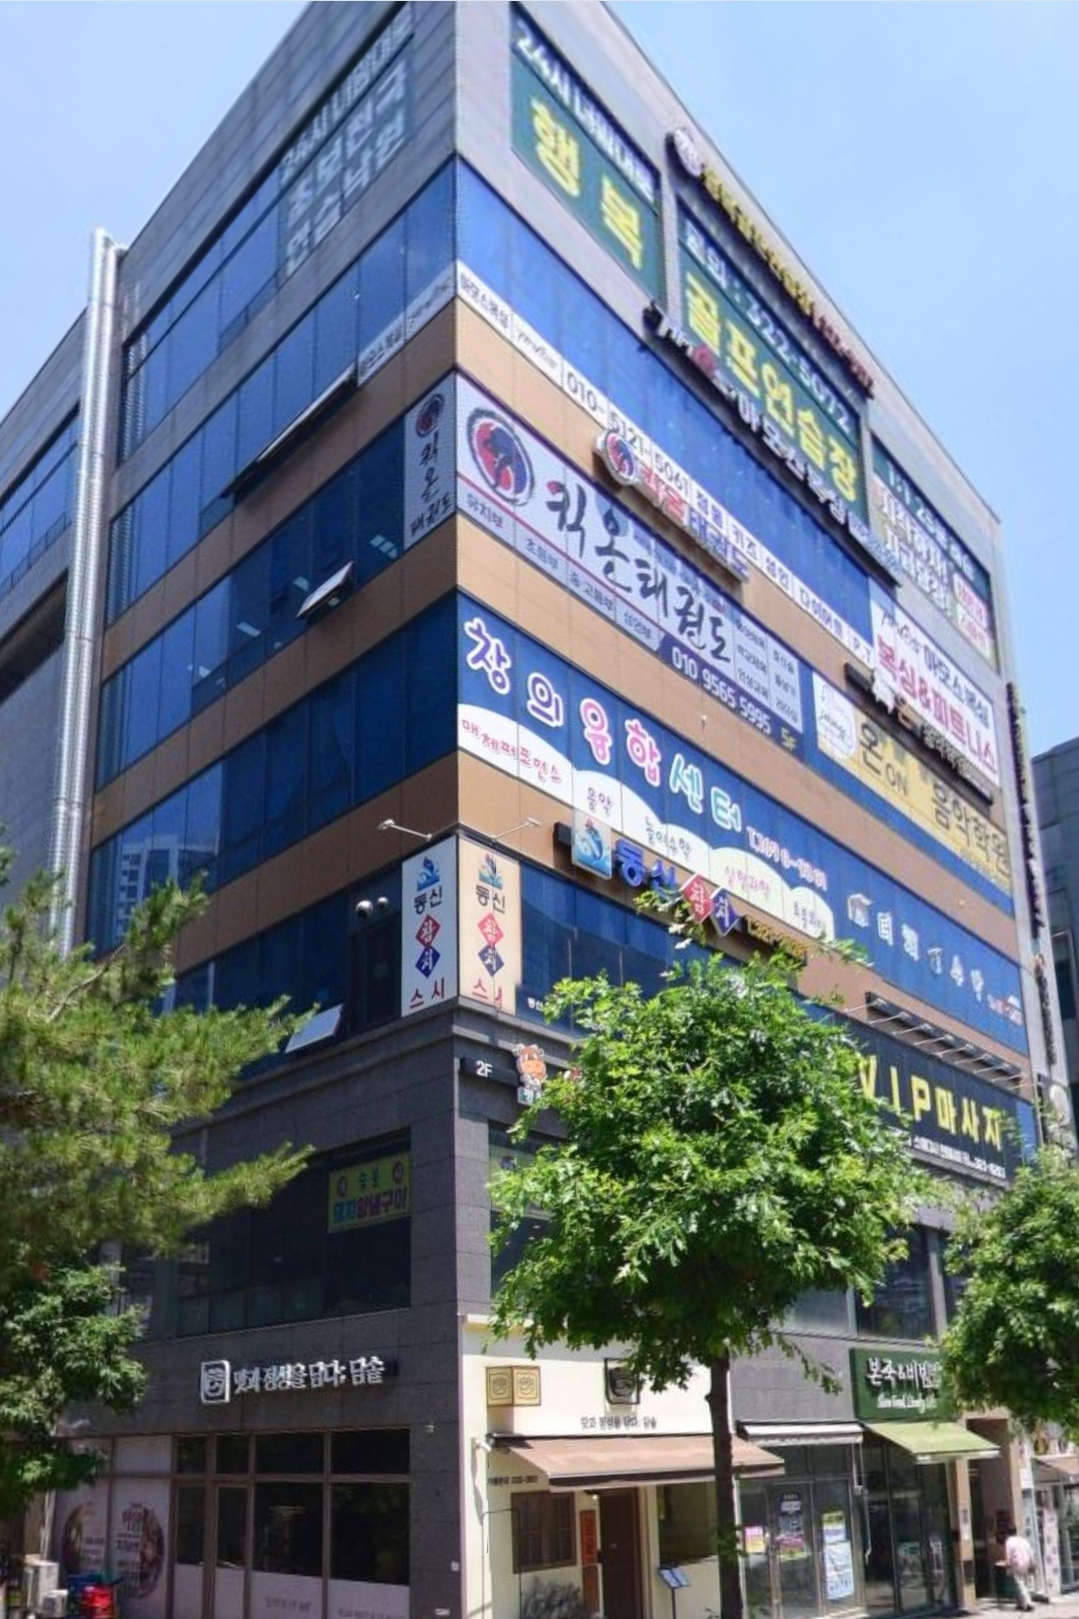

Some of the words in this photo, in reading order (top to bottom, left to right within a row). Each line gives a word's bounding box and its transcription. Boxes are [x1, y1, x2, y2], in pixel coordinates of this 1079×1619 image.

[684, 270, 857, 503] 골프연습장
[672, 646, 698, 679] 010
[702, 668, 736, 709] 9565
[464, 616, 743, 834] 창의융합센터
[877, 633, 997, 774] 복싱&피트니스
[588, 786, 614, 815] 음악
[860, 721, 882, 777] 온
[931, 781, 1012, 879] 음악학원
[413, 885, 443, 915] 동신
[475, 884, 506, 914] 동신
[409, 976, 446, 1009] 스시
[475, 1060, 493, 1078] 2F
